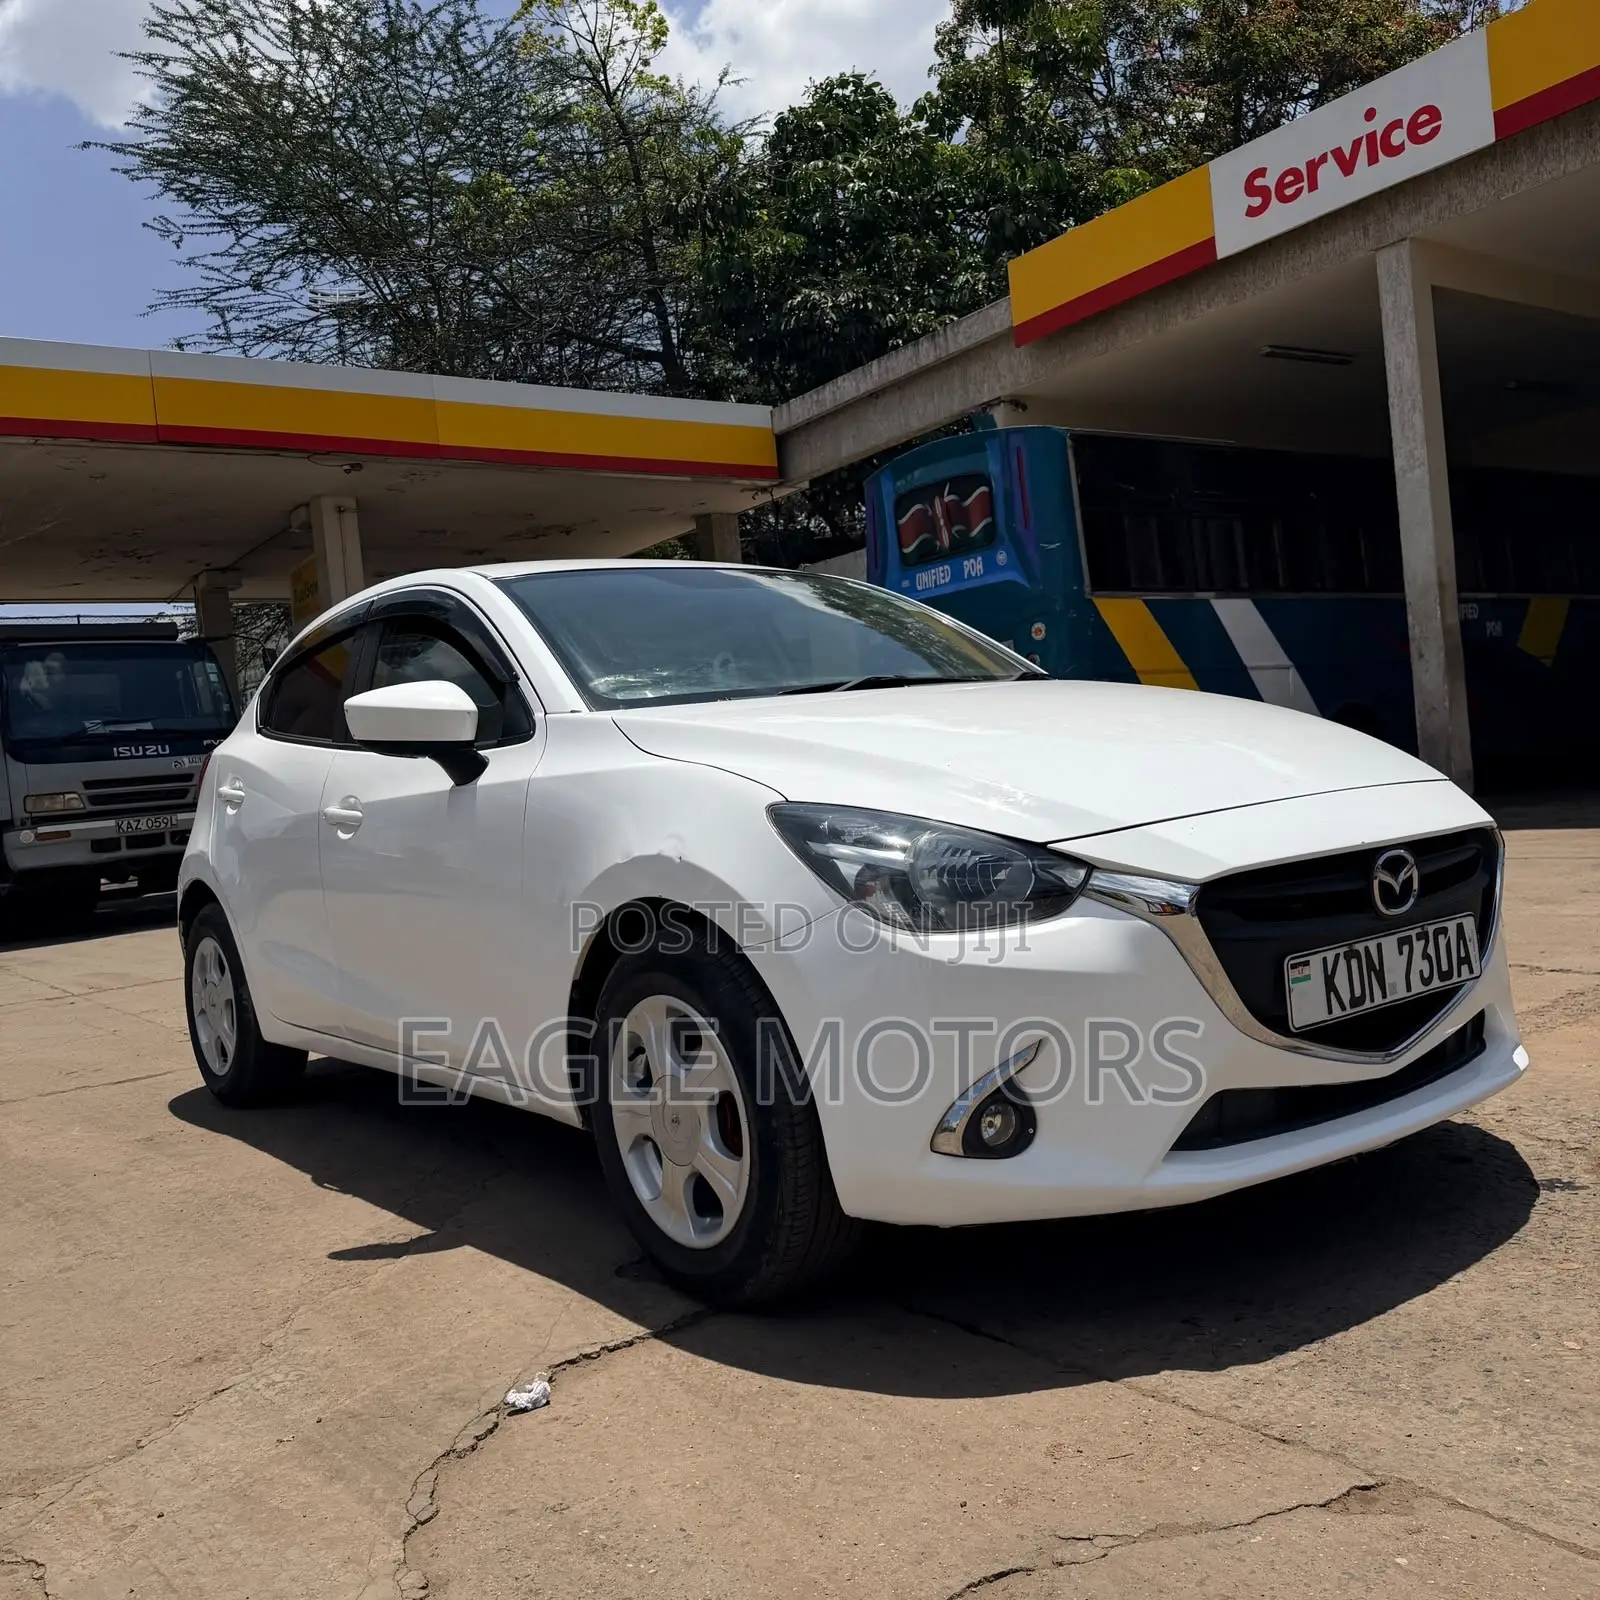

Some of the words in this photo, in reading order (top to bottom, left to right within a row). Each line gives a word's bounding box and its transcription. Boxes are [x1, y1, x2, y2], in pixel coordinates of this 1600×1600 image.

[1244, 104, 1442, 218] Service
[915, 565, 951, 590] UNIFIED
[963, 556, 984, 579] POA
[113, 745, 170, 757] ISUZU
[117, 821, 143, 833] KAZ
[146, 817, 177, 830] 059L
[1322, 942, 1387, 1015] KDN
[1397, 922, 1474, 993] 730A
